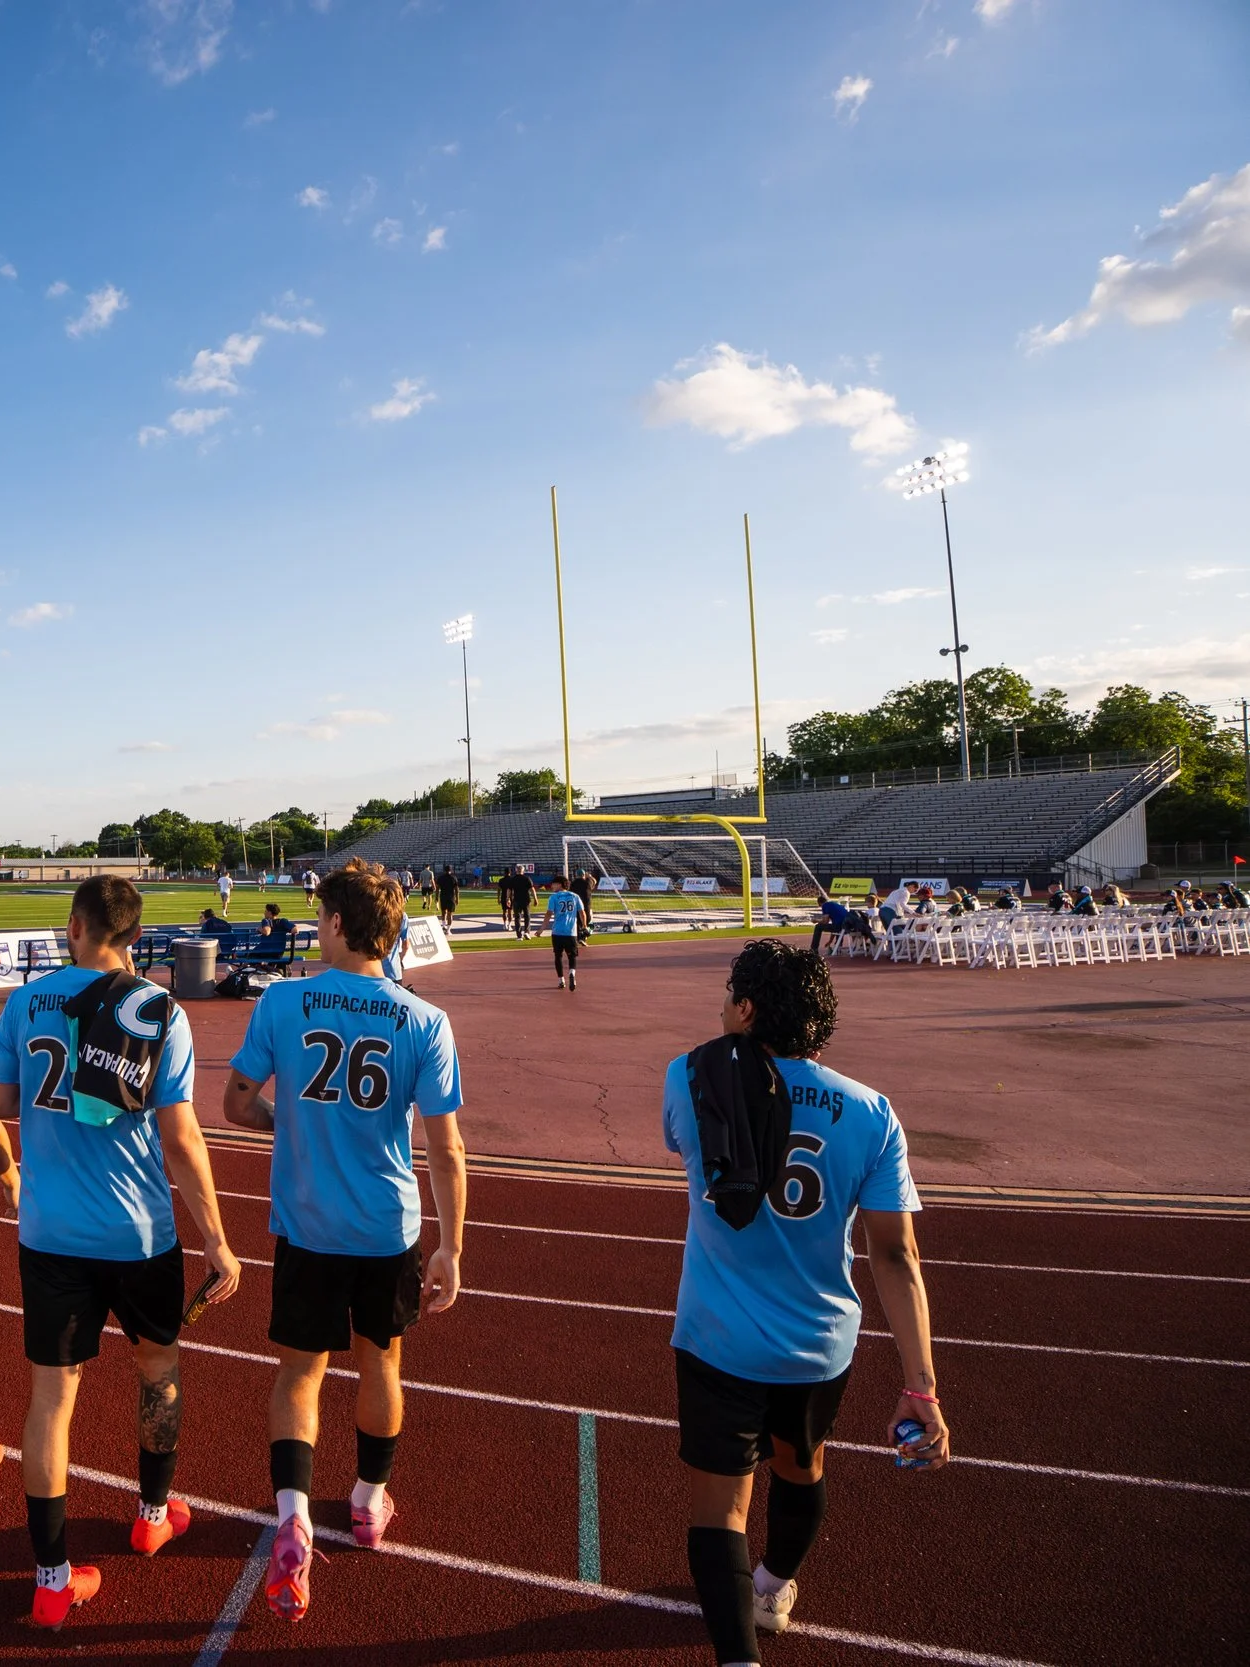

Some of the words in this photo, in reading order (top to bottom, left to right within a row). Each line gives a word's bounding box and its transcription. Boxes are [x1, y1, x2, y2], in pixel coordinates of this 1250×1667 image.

[559, 900, 575, 913] 26
[302, 991, 409, 1032] CHUPACABRAS
[26, 1035, 70, 1113] 2
[78, 1043, 151, 1089] CHUPACA
[300, 1029, 392, 1111] 26
